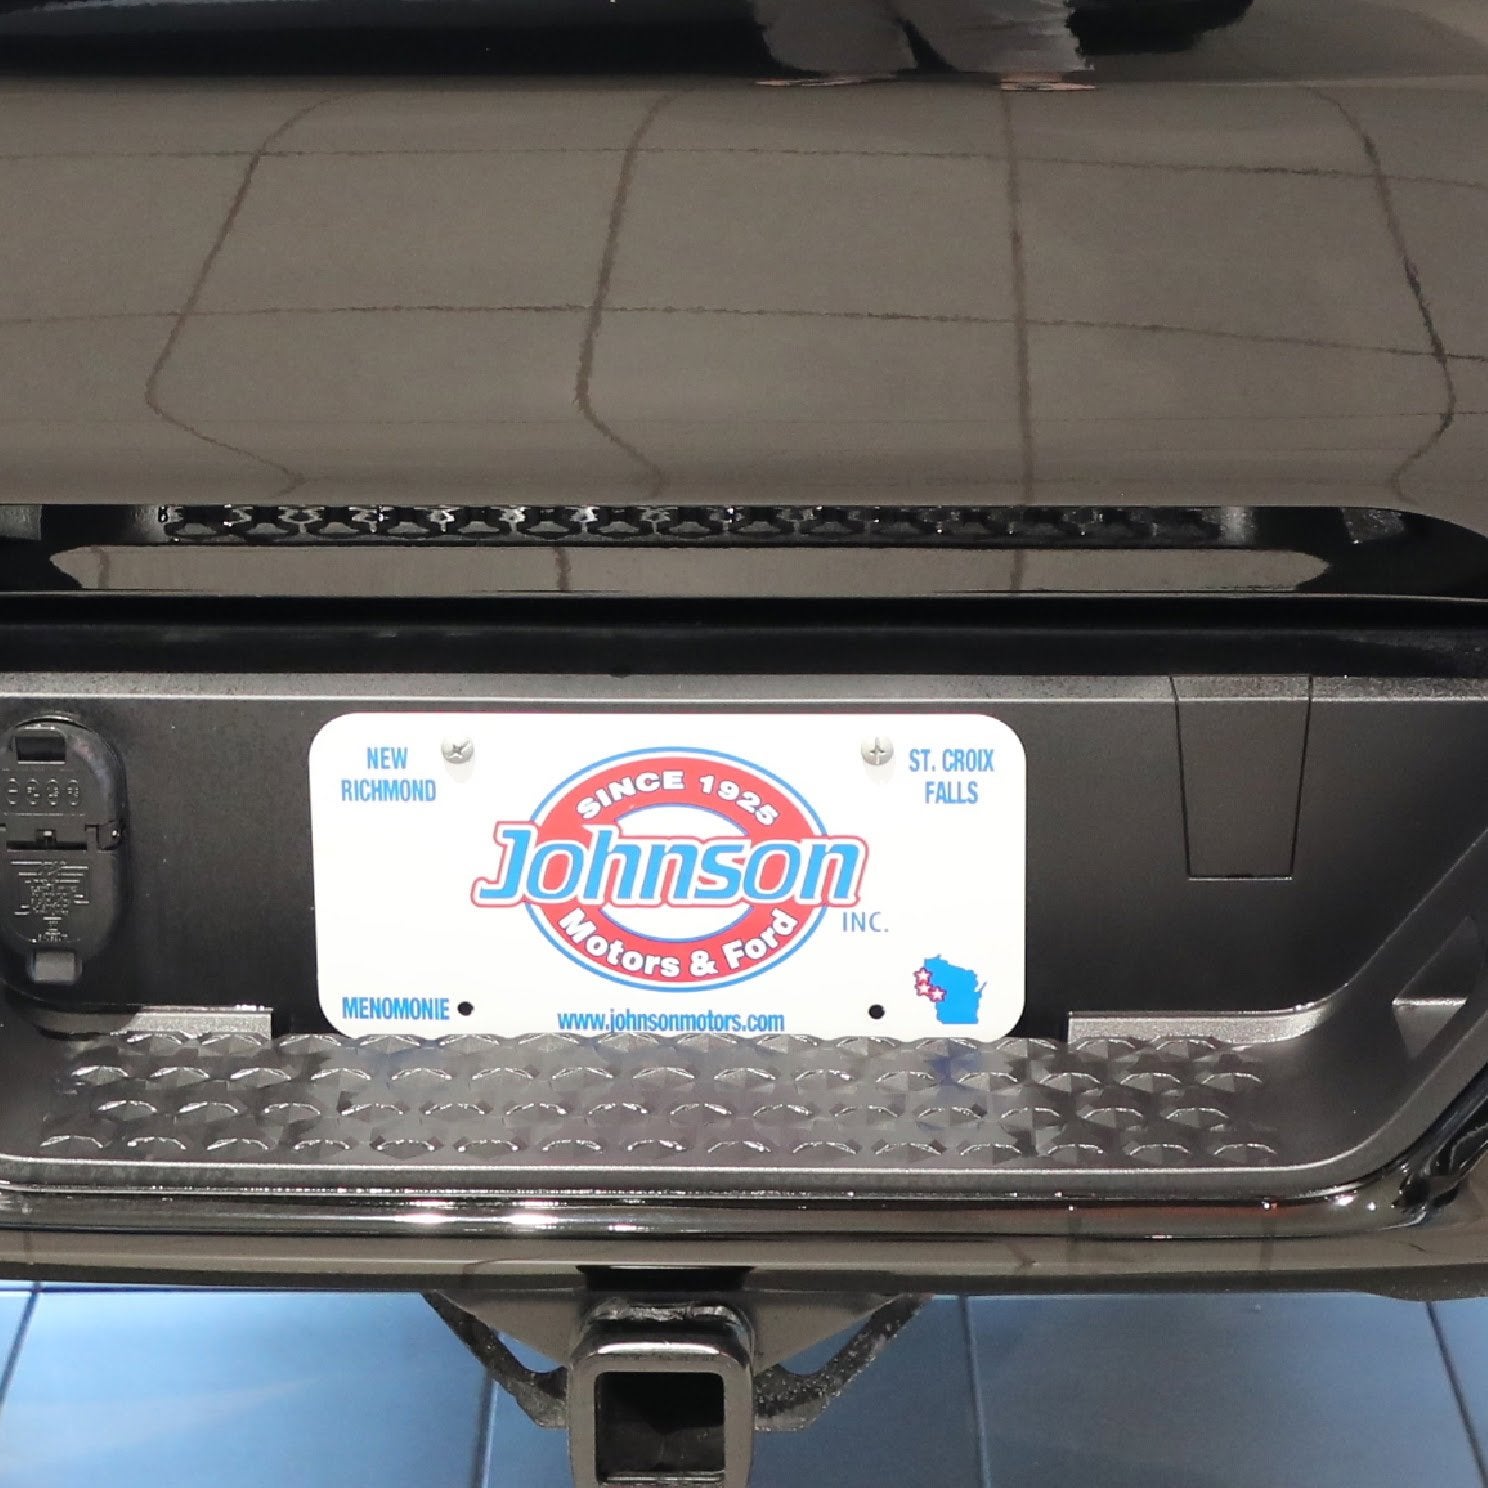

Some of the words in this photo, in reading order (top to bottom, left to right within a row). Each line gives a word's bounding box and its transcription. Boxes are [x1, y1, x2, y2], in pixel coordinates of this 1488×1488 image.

[366, 747, 408, 770] NEW
[910, 749, 938, 772] ST.
[943, 749, 995, 772] CROIX
[341, 780, 437, 802] RICHMOND
[576, 771, 685, 819] SINCE
[699, 775, 779, 826] 1925
[925, 781, 979, 805] FALLS
[472, 821, 869, 907] Johnson
[843, 912, 889, 933] INC.
[559, 907, 681, 977] Motors
[689, 950, 718, 977] &
[721, 907, 799, 970] Ford
[341, 997, 450, 1021] MENOMONIE
[557, 1009, 786, 1034] www.johnsonmotors.com
